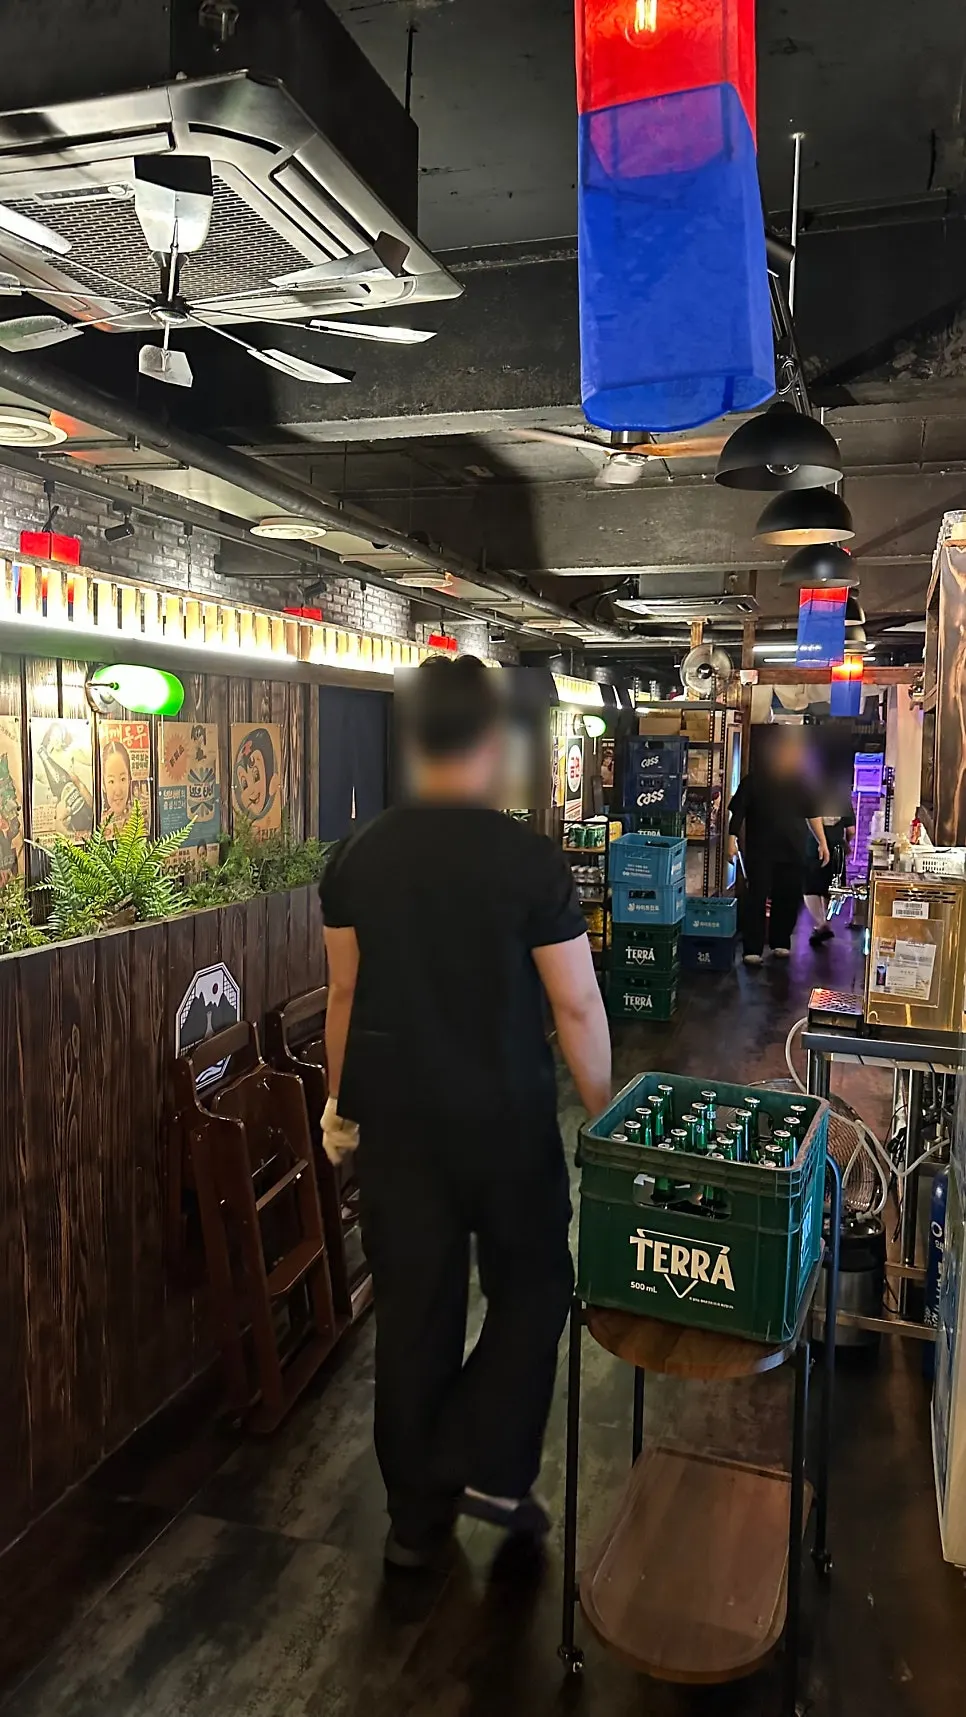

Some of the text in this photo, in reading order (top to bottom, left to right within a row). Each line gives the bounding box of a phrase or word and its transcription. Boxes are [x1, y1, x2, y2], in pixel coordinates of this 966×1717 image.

[100, 724, 147, 748] 깨동무
[636, 789, 665, 807] Cass
[625, 947, 655, 961] TERRA
[623, 994, 653, 1008] TERRA
[629, 1230, 735, 1291] TERRA
[630, 1281, 658, 1293] 500 mL
